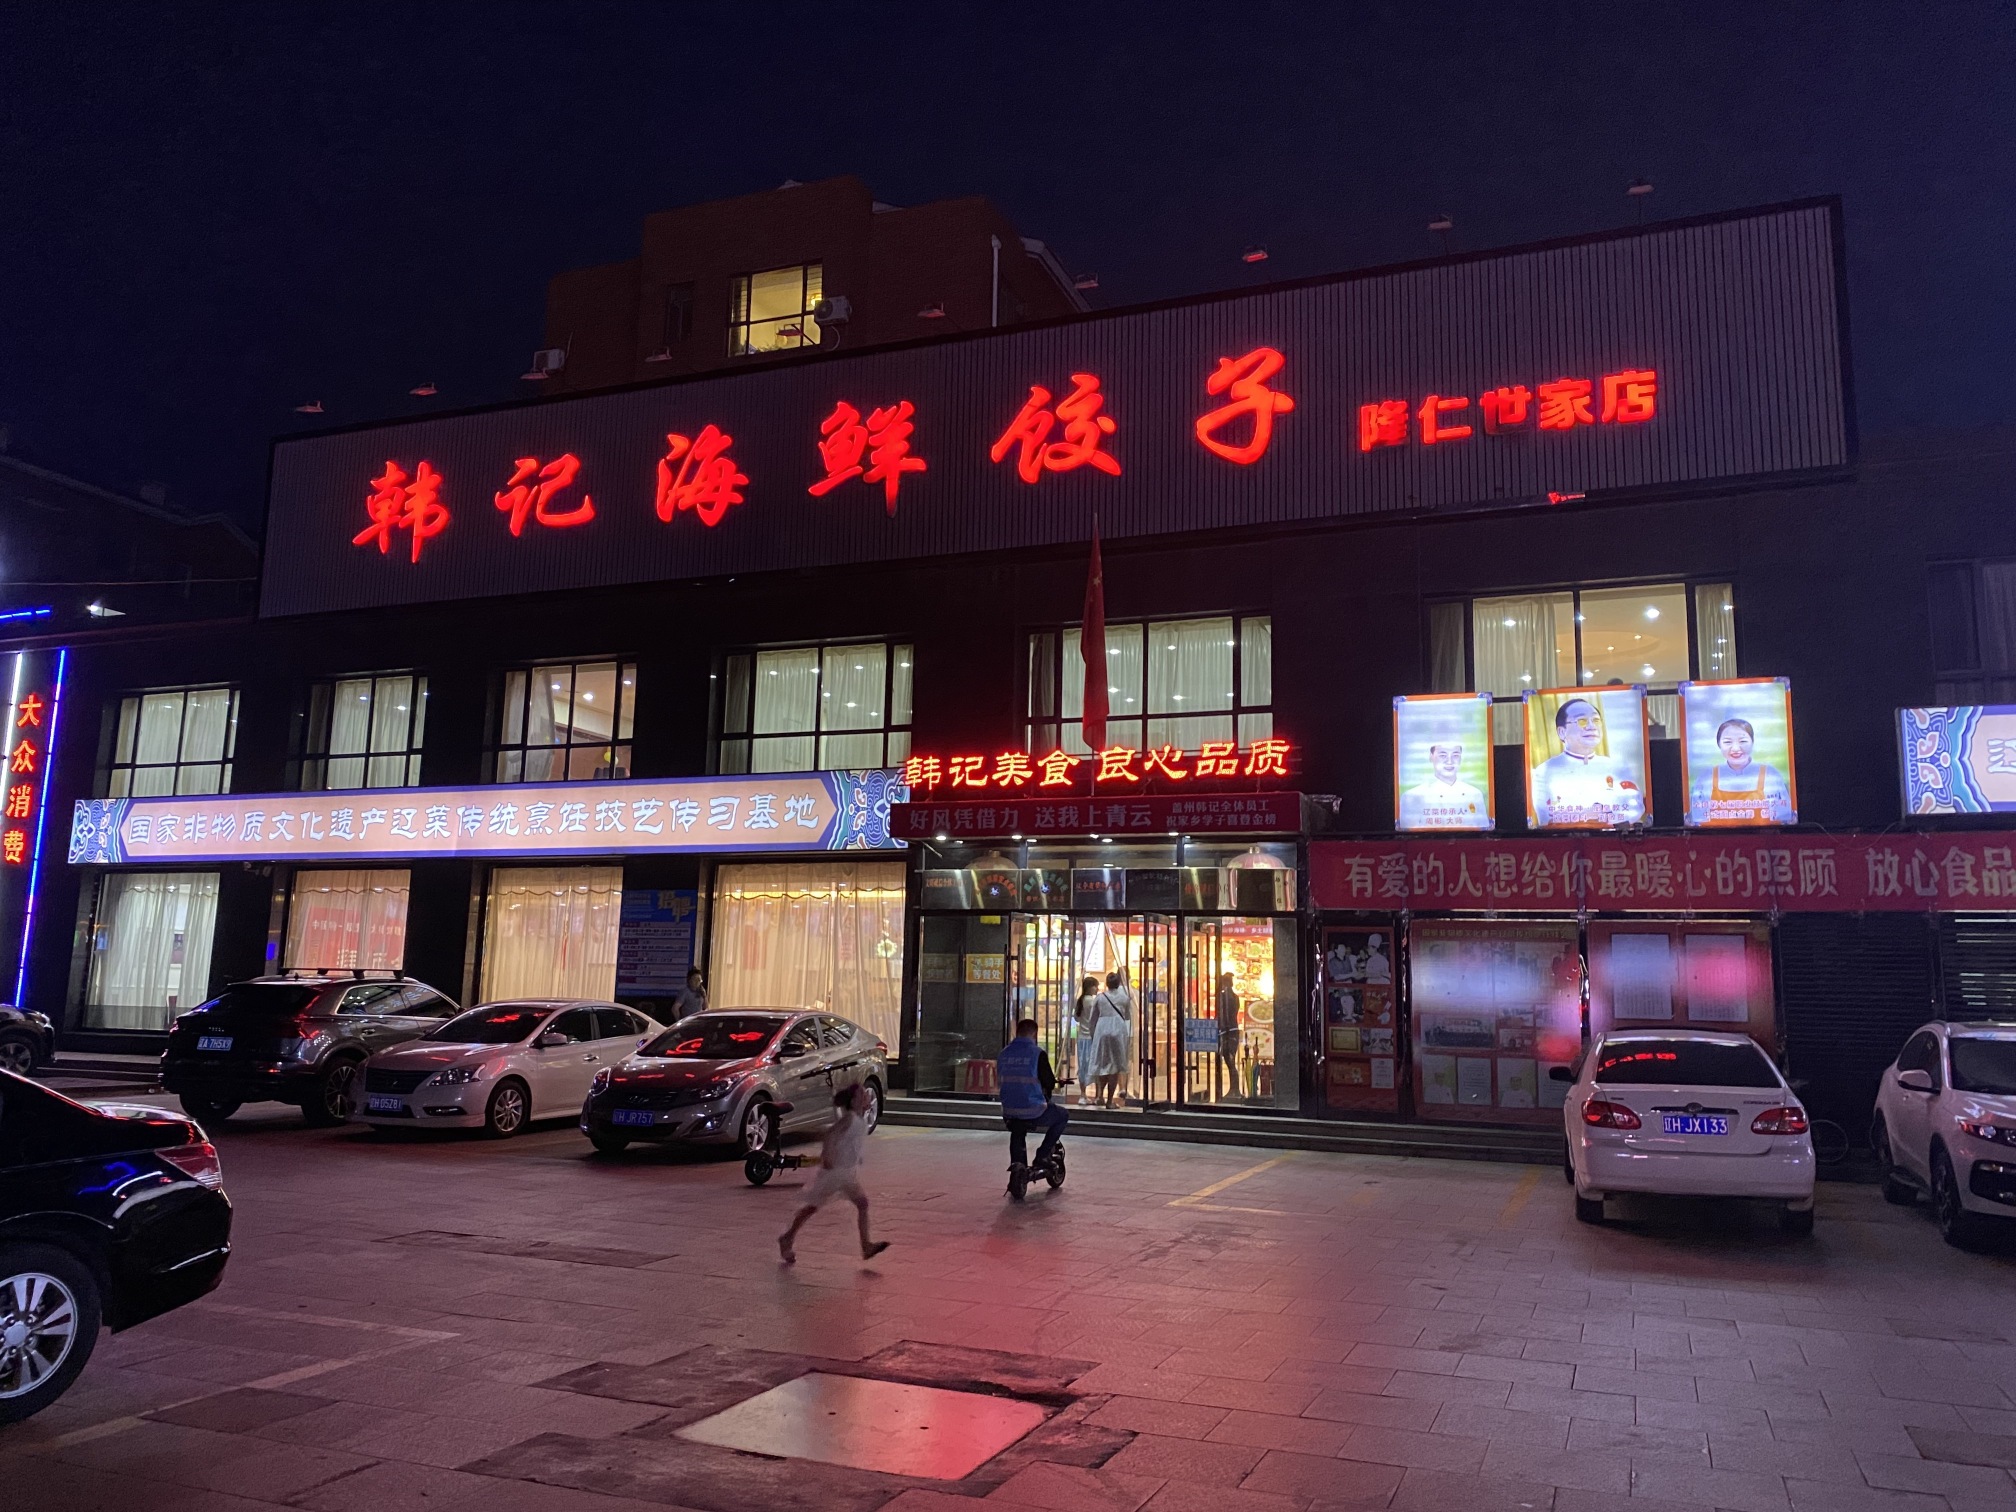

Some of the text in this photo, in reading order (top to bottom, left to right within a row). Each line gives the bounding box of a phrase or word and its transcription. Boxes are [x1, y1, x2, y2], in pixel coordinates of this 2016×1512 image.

[1360, 369, 1657, 452] 隆仁世家店
[351, 346, 1295, 564] 韩记海鲜饺子
[3, 694, 43, 864] 大众消费
[905, 738, 1291, 791] 韩记美食 良心品质
[128, 793, 819, 845] 国家非物质文化遗产辽菜传统烹饪技艺传习基地
[909, 803, 1153, 831] 好风凭借力 送我上青云
[1343, 844, 2016, 899] 有爱的人想给你最暖心的照顾 放心食品
